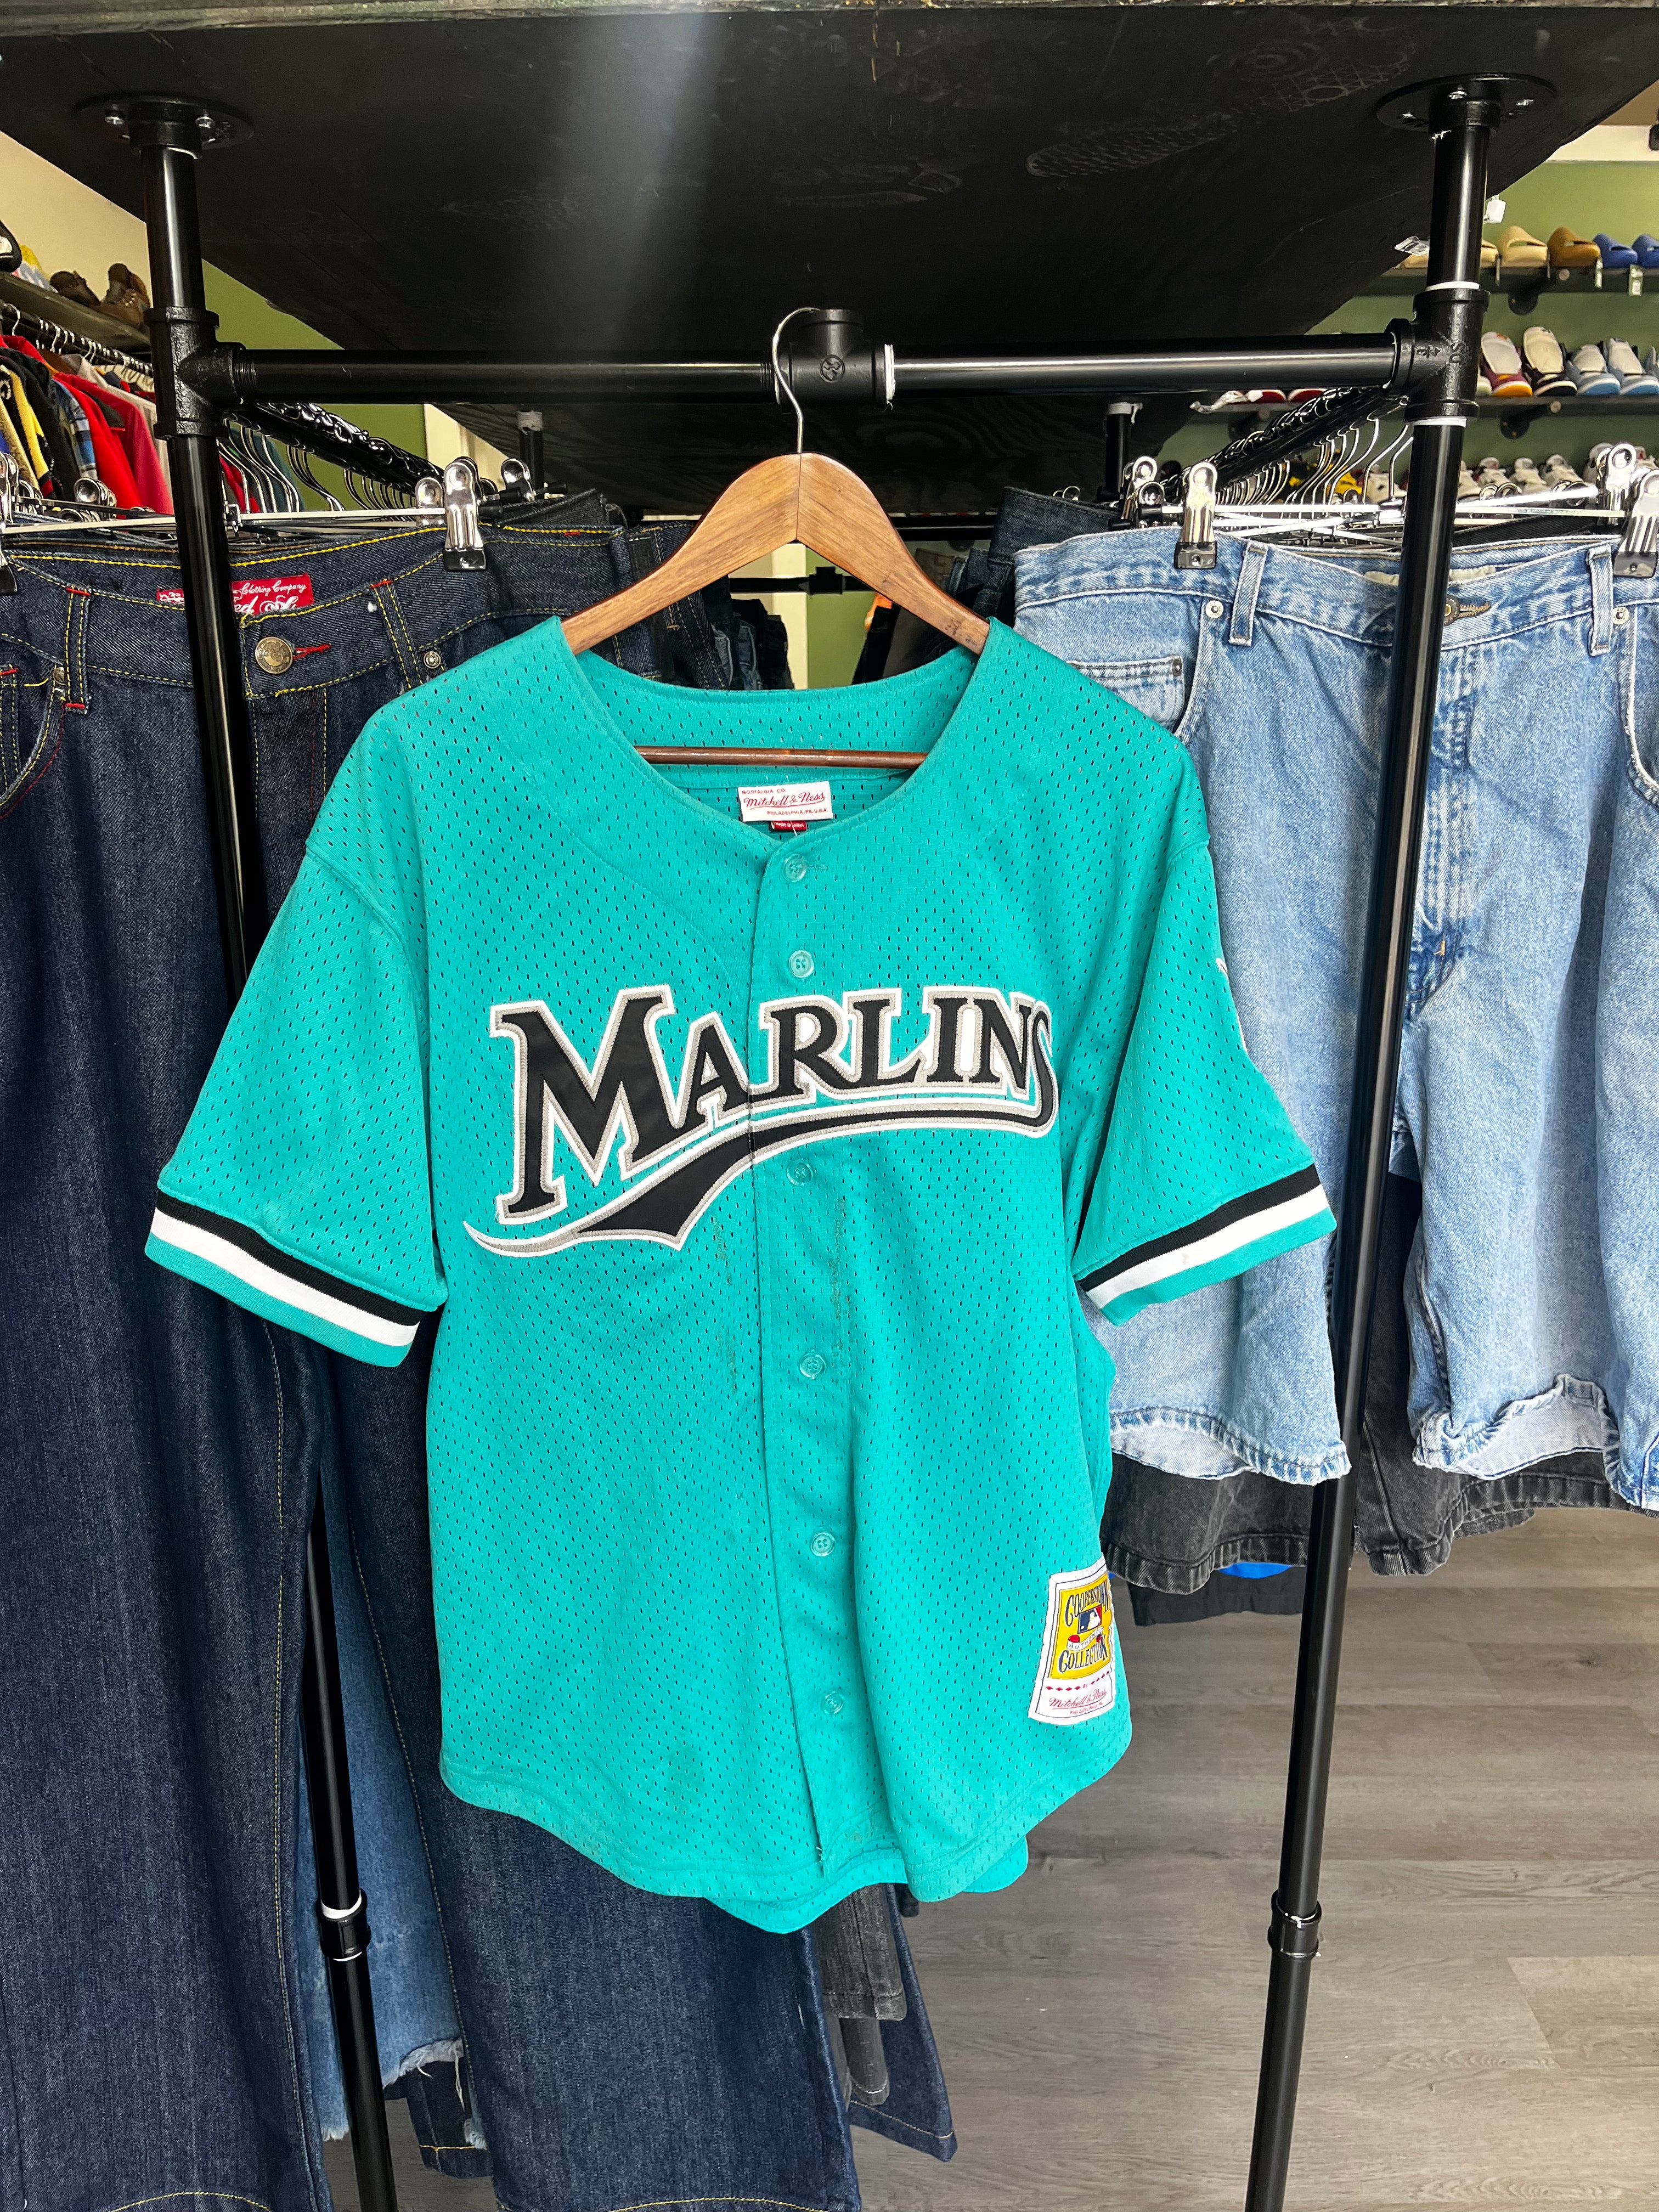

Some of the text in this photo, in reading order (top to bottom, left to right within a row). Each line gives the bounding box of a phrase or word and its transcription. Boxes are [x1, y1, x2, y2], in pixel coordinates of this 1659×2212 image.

[241, 579, 307, 597] Clothing Company
[743, 792, 825, 808] Mitchell & Ness
[488, 982, 1060, 1226] MARLINS
[1049, 1689, 1107, 1708] Mitchell & Ness
